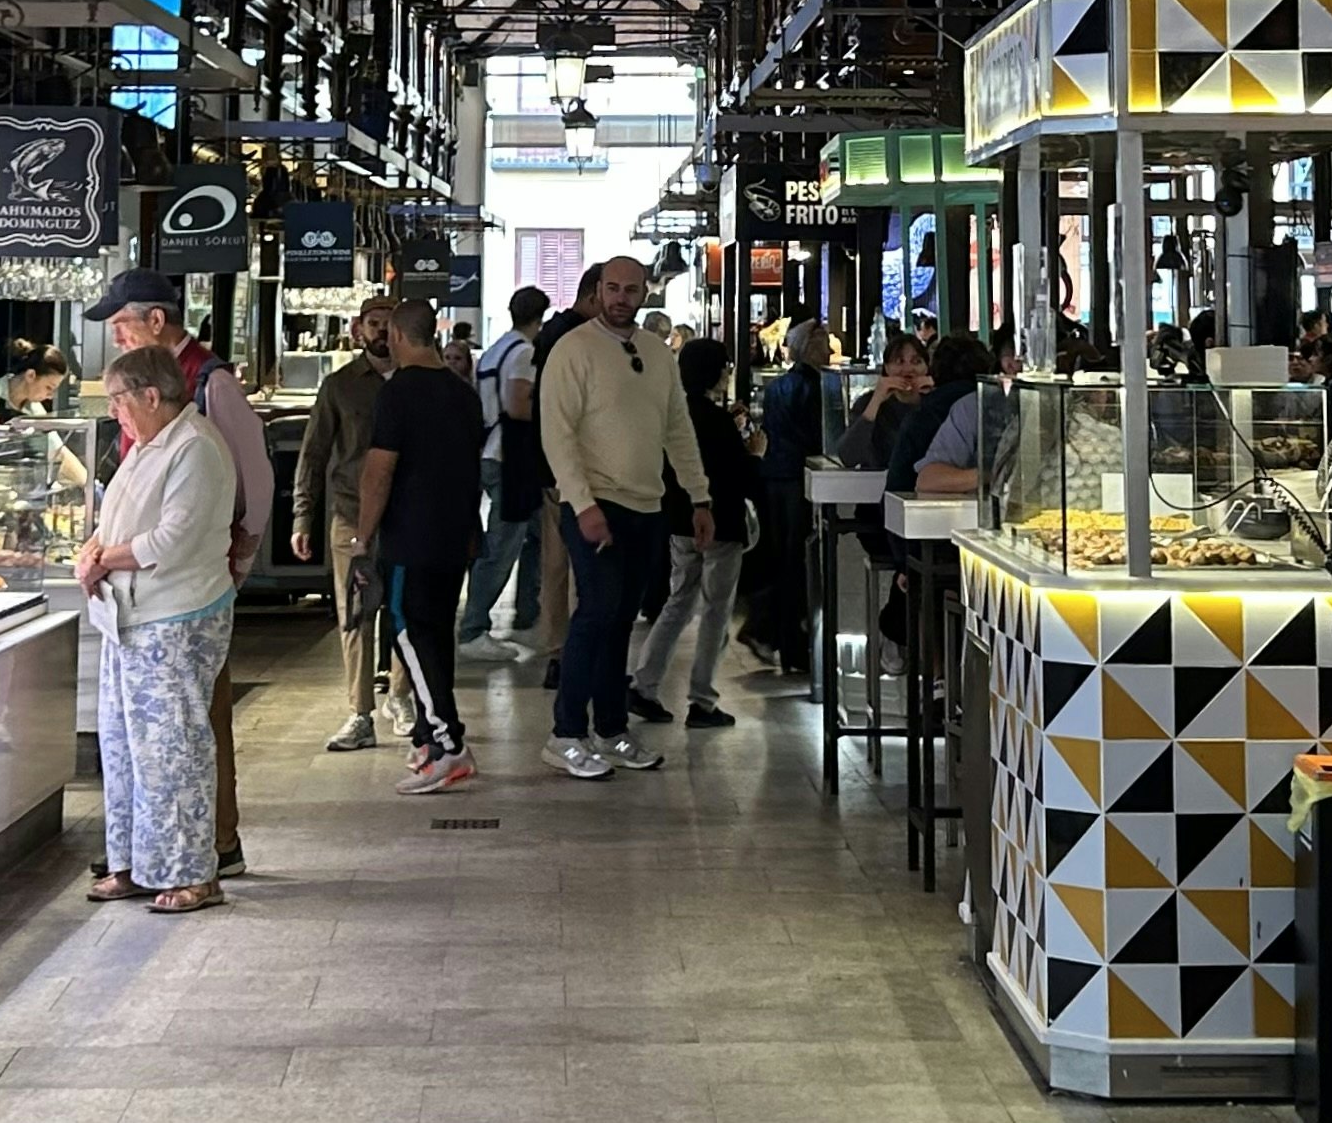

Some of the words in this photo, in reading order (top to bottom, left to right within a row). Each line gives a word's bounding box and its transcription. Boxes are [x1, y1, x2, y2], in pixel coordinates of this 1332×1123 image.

[785, 180, 821, 202] PES
[0, 205, 81, 217] AHUMADOS
[785, 205, 839, 225] FRITO
[161, 238, 200, 247] DANIEL
[615, 741, 630, 752] N
[565, 747, 580, 759] N
